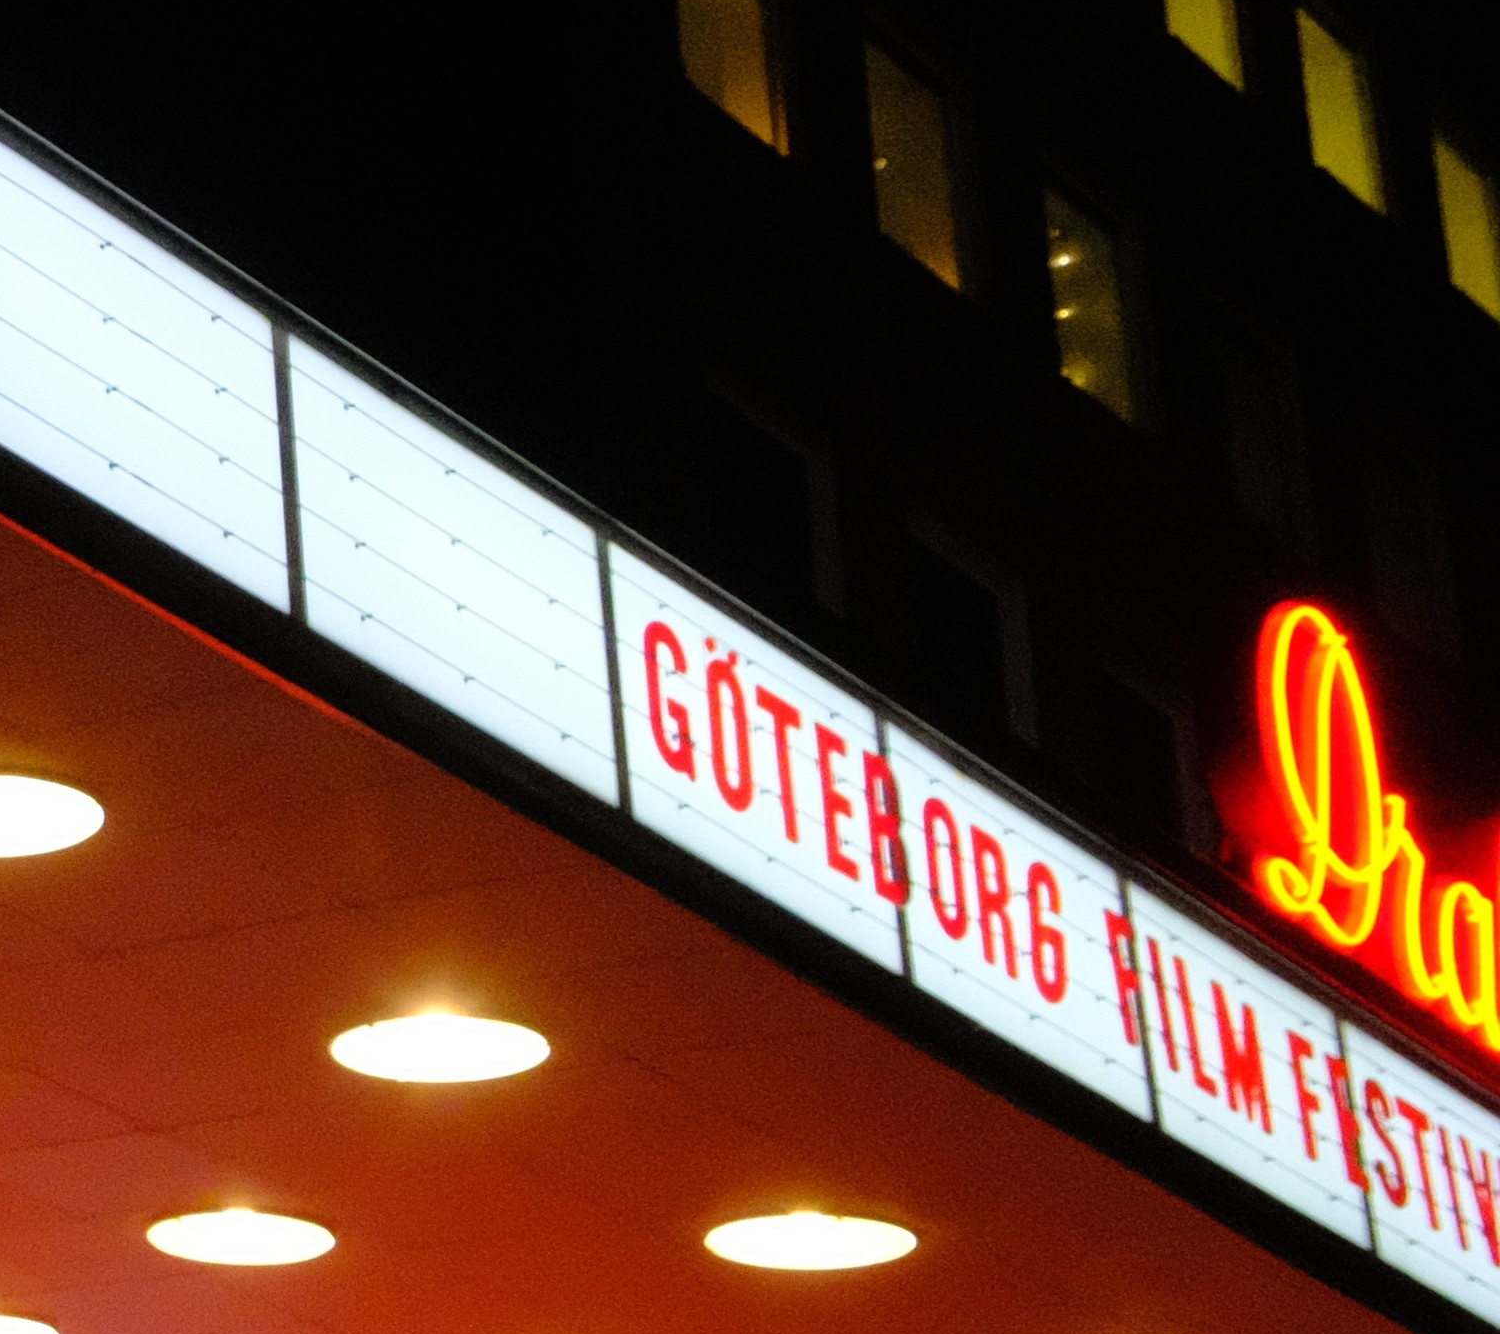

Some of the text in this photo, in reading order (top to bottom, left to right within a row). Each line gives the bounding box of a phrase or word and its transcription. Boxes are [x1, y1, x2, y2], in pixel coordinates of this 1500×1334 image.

[643, 621, 1500, 1268] GÖTEBORG FILM FESTIV
